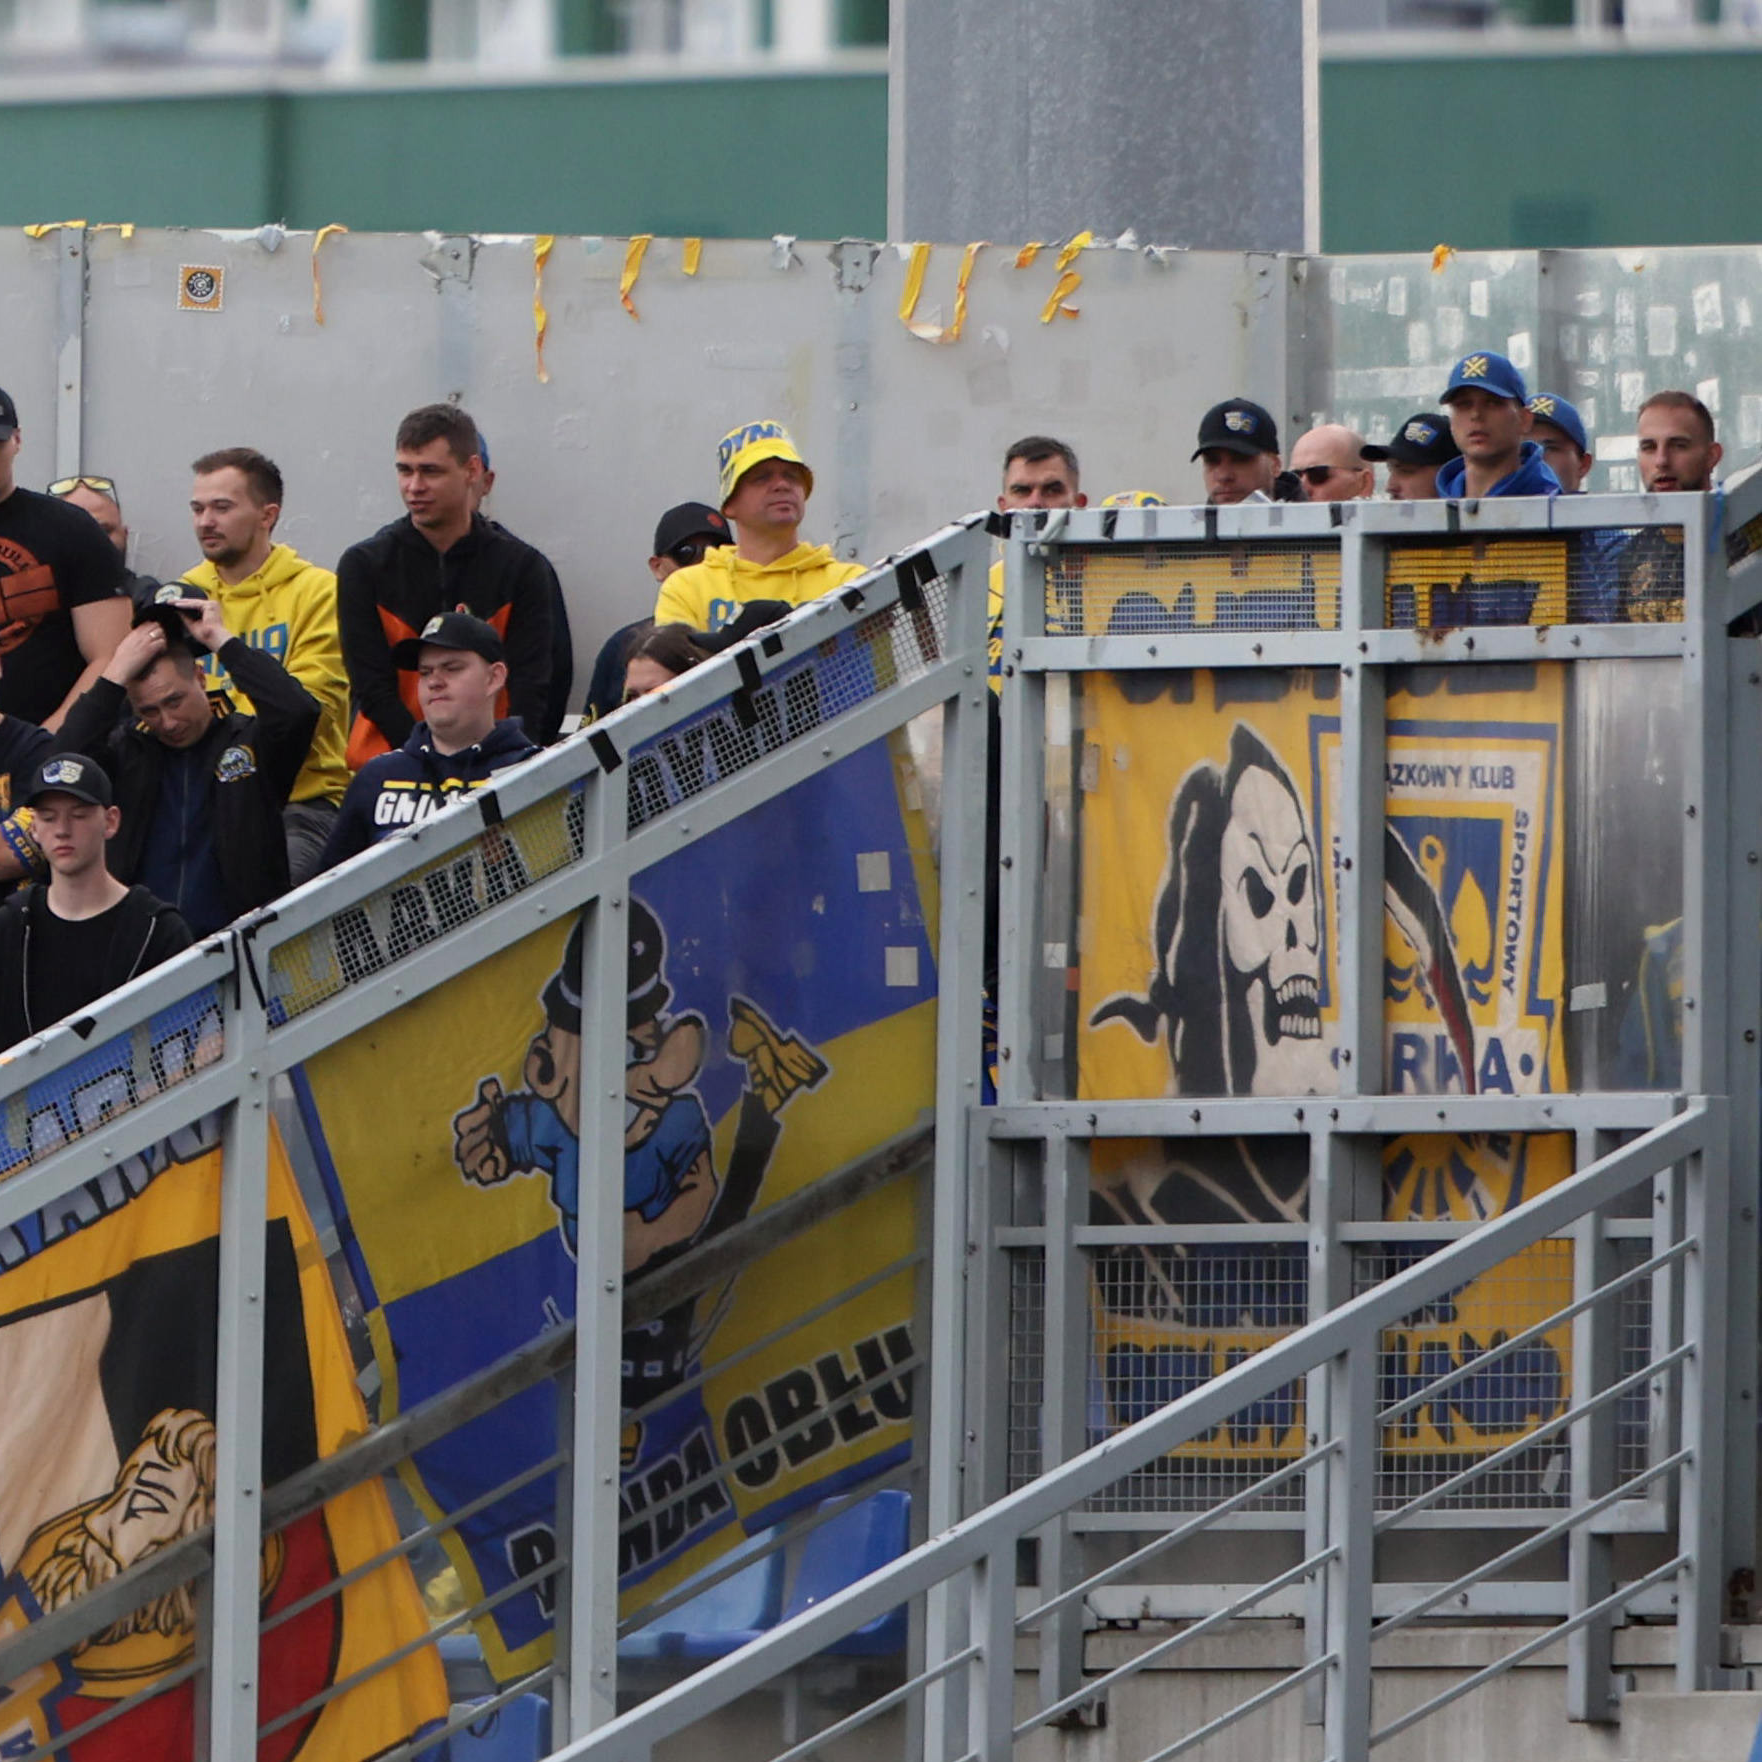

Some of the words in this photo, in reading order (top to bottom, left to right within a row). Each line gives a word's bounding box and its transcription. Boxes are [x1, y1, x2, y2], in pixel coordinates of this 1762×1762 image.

[1387, 763, 1463, 793] ĄZKOWY
[1469, 763, 1515, 790] KLUB
[1501, 808, 1530, 996] SPORTOWY
